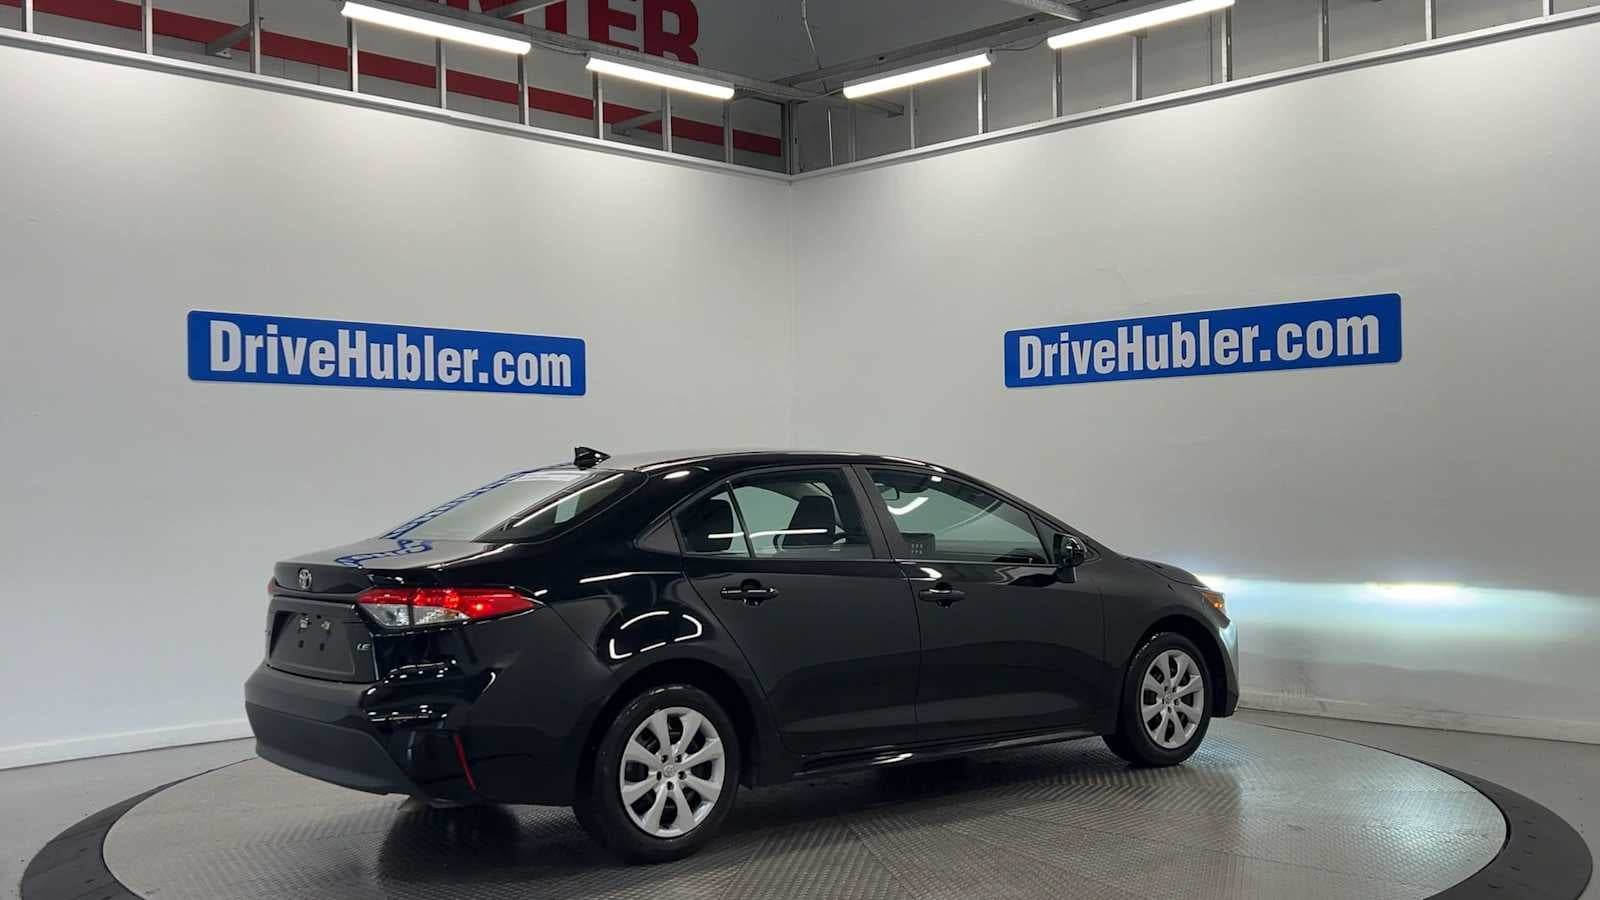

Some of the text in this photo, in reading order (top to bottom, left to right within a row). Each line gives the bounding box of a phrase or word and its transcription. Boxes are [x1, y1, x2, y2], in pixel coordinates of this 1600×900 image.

[209, 319, 572, 387] DriveHubler.com
[1018, 313, 1380, 379] DriveHubler.com
[356, 643, 371, 651] LE
